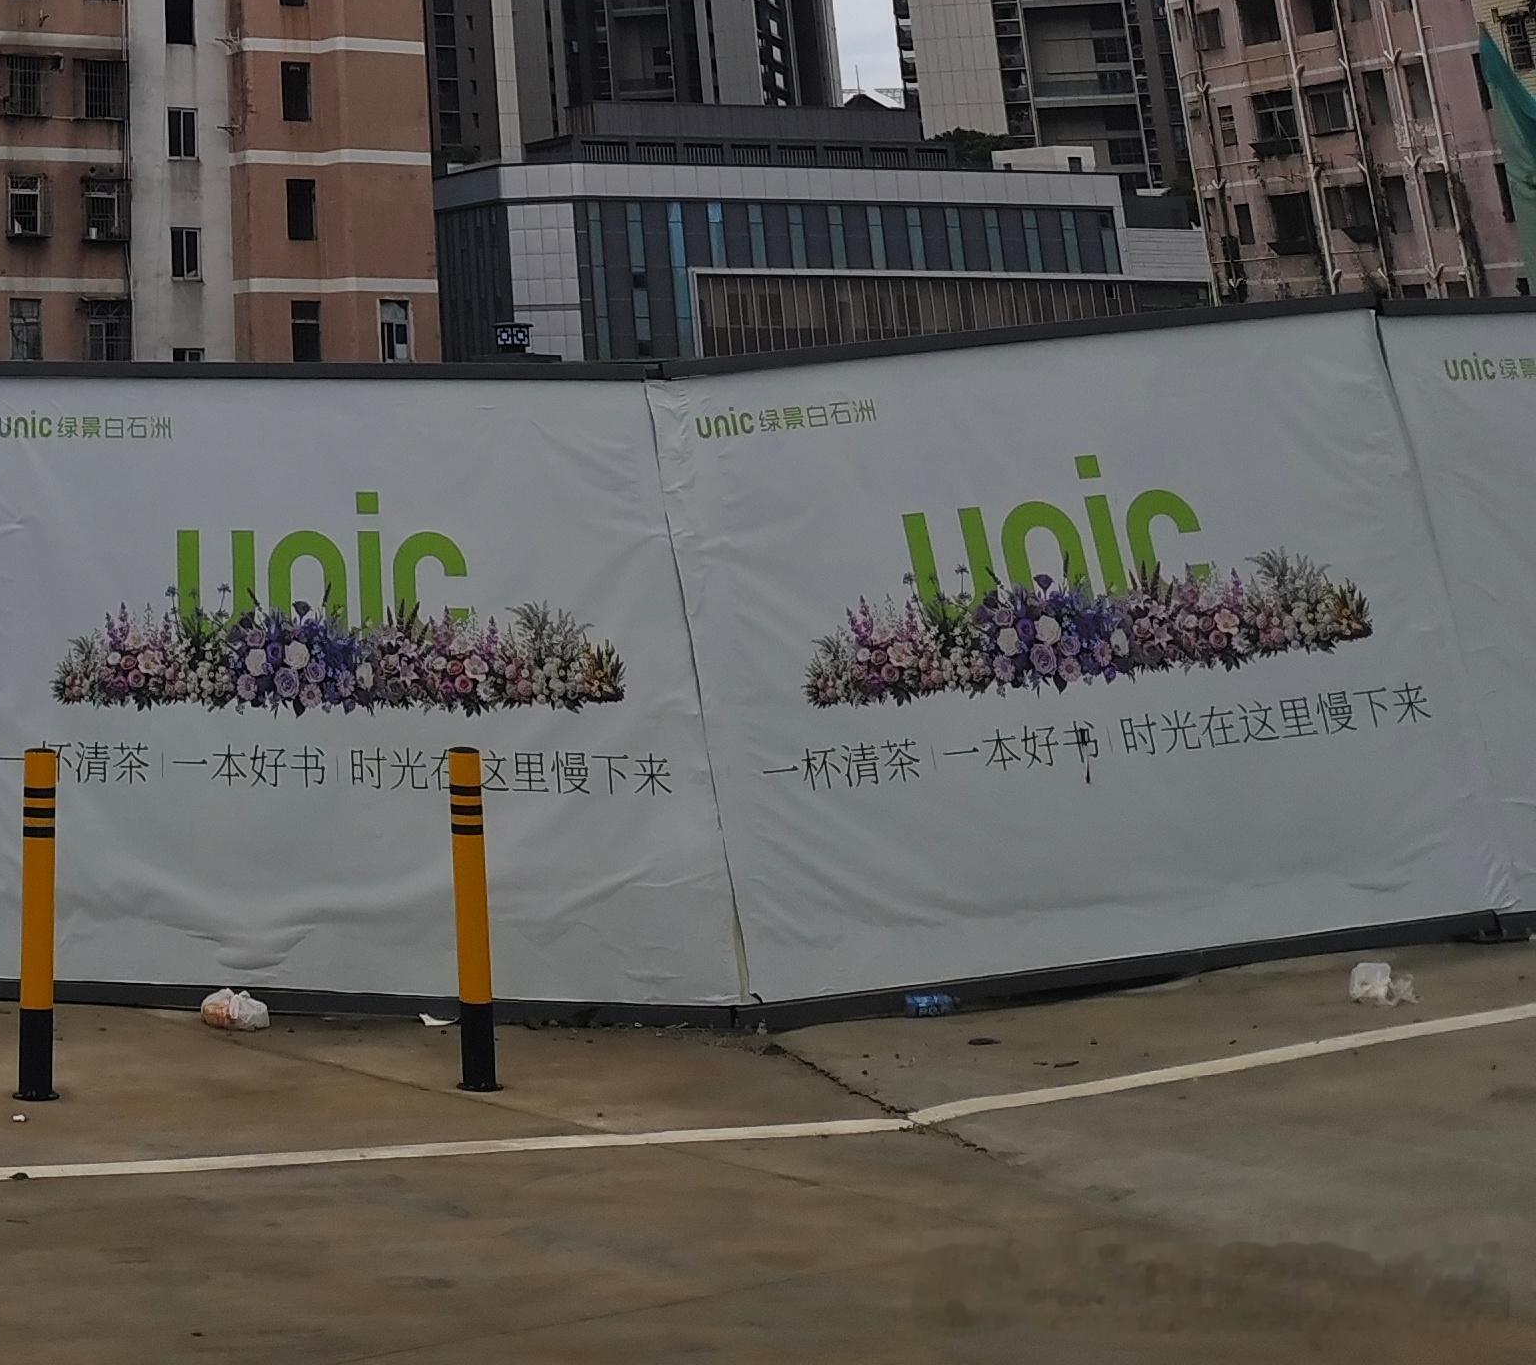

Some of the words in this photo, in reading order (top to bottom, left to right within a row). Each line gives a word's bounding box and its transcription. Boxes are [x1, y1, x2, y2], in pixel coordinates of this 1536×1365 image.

[57, 416, 172, 439] 绿景白石洲
[696, 406, 755, 439] unic
[758, 398, 877, 432] 绿景白石洲
[176, 491, 470, 641] unic
[901, 455, 1211, 619] unic
[171, 744, 327, 789] 一本好书
[763, 738, 921, 791] 一杯清茶
[942, 720, 1100, 771] 一本好书
[1119, 681, 1432, 755] 时光在这里慢下来
